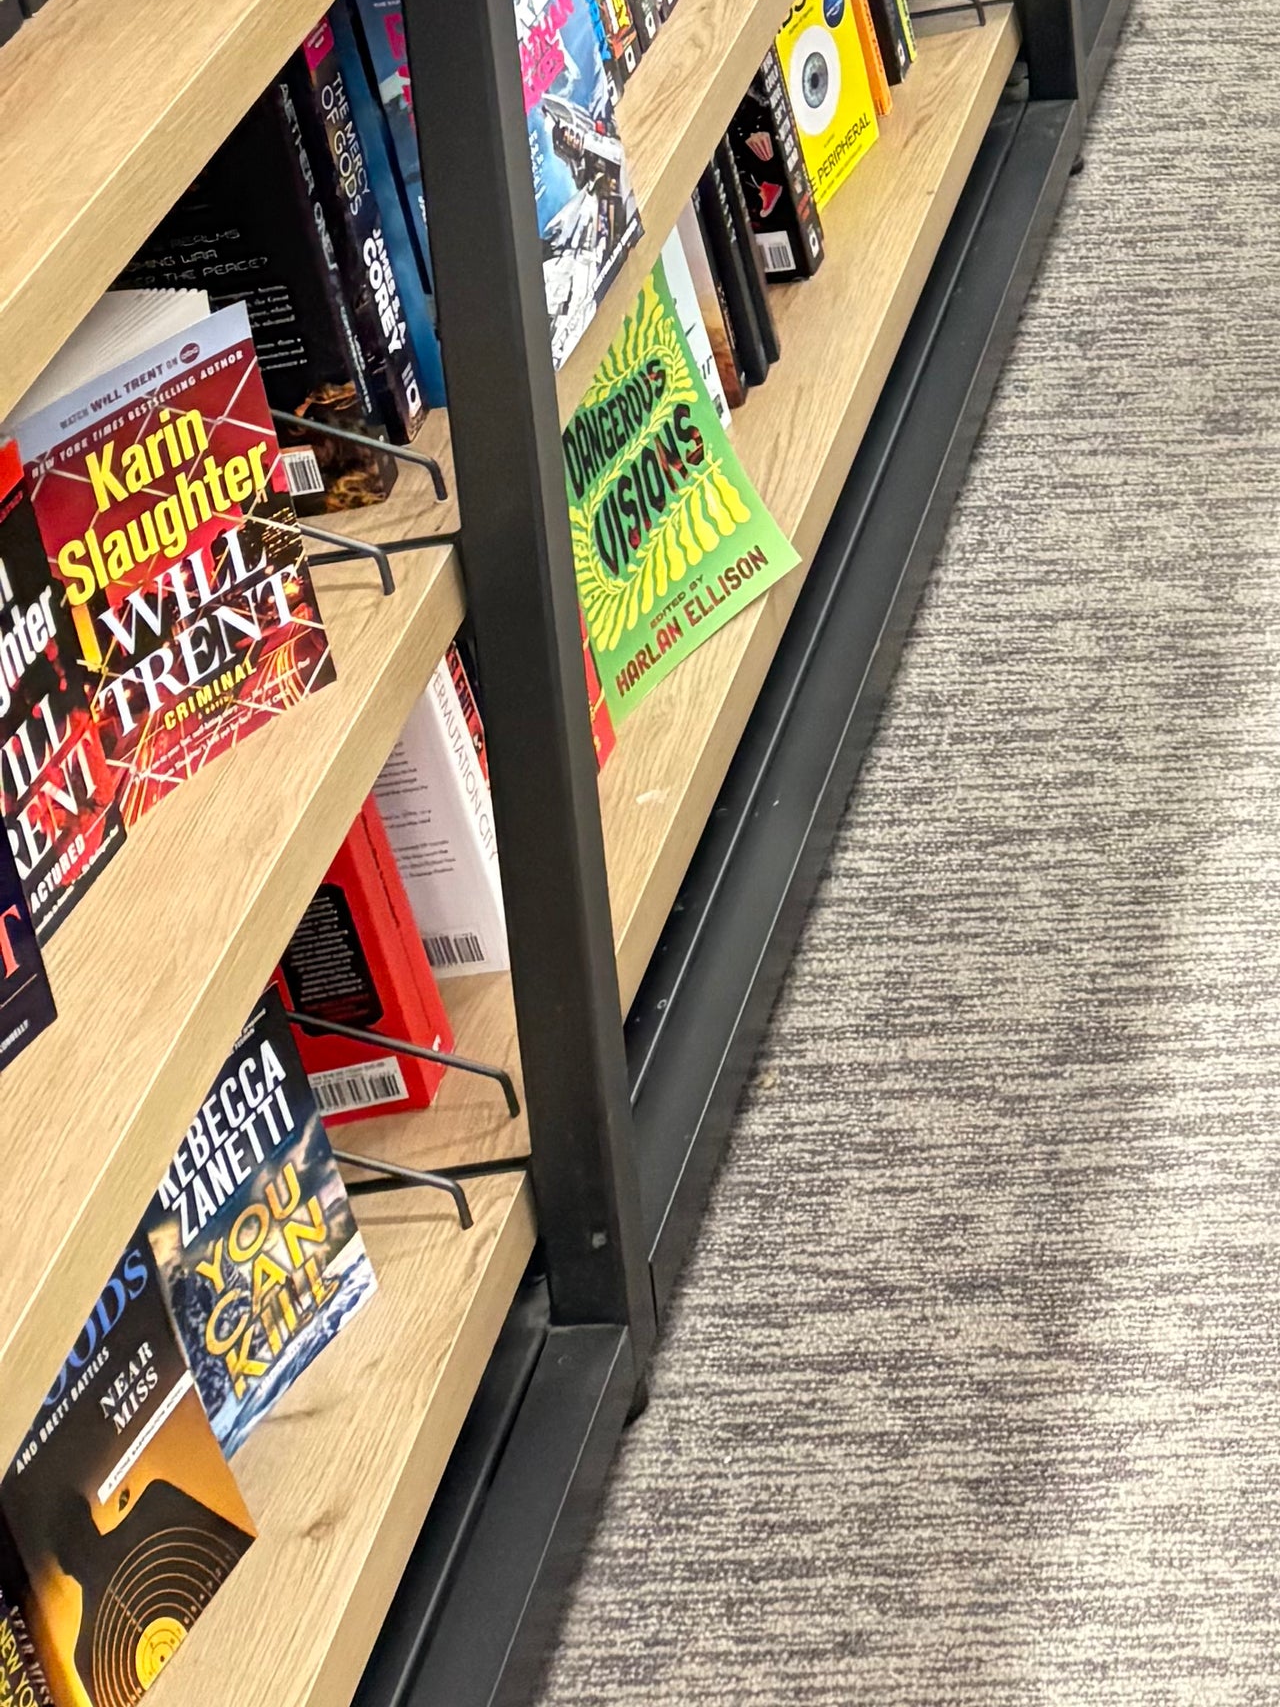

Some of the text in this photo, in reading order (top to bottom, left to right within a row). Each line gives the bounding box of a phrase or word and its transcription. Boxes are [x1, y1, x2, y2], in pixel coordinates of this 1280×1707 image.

[332, 130, 363, 216] GODS
[816, 115, 871, 185] PERIPHERAL
[362, 238, 404, 355] COREY
[31, 349, 244, 478] NEW YORK TIMES BESTSELLING AUTHOR
[89, 366, 163, 419] WILL TRENT
[563, 359, 666, 500] DANGEROUS
[58, 440, 268, 607] Slaughter
[85, 408, 209, 513] Karin
[594, 404, 704, 576] VISIONS
[98, 526, 267, 657] WILL
[100, 564, 299, 738] TRENT
[616, 545, 768, 698] HARLAN ELLISON
[163, 660, 257, 732] CRIMINAL
[171, 1084, 295, 1248] ZANETTI
[196, 1162, 301, 1293] YOU
[205, 1196, 327, 1357] CAN
[225, 1258, 340, 1404] KILL
[16, 1347, 110, 1475] AND BRETT BATTLES
[98, 1341, 155, 1419] NEAR
[112, 1366, 161, 1435] MISS
